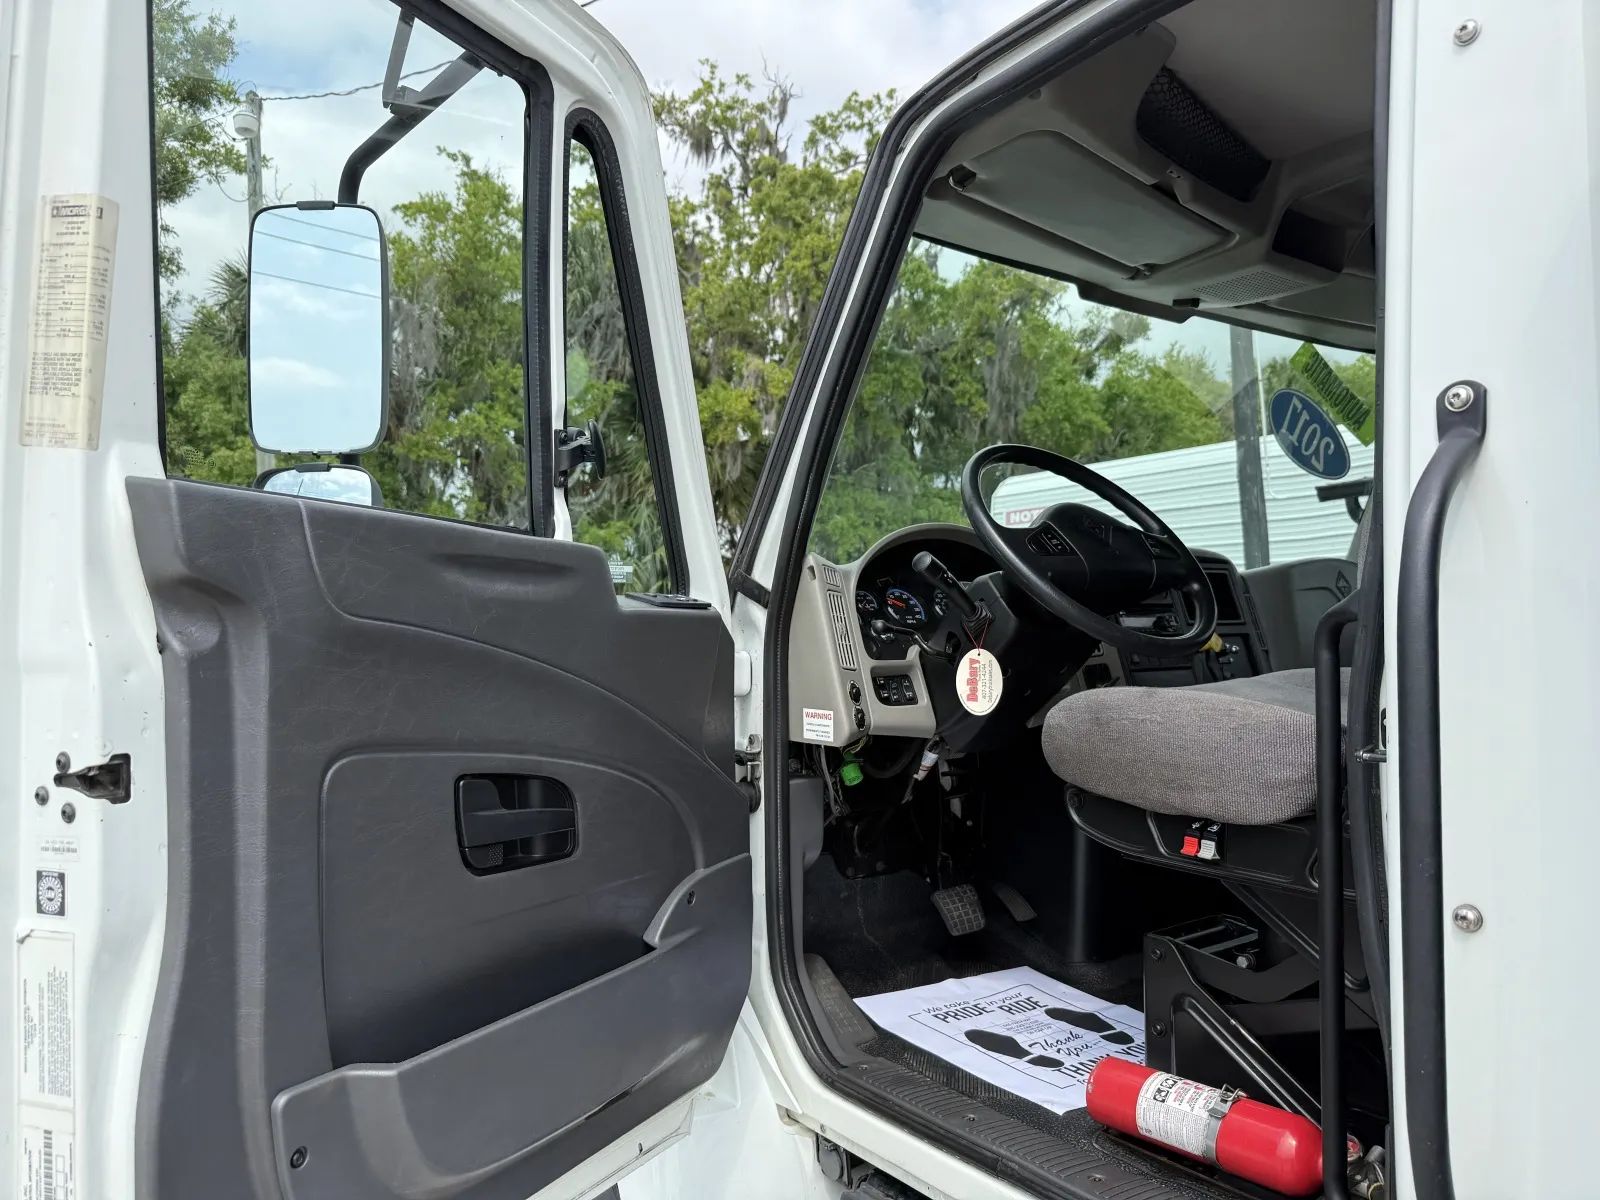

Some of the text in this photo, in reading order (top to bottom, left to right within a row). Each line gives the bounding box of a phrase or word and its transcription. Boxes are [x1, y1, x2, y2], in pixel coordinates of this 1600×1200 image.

[59, 206, 101, 217] MORGN
[966, 657, 981, 702] DeBary
[804, 711, 832, 721] WARNING
[923, 1000, 970, 1015] We take
[931, 992, 1023, 1024] PRIDE in your
[997, 996, 1049, 1015] RIDE
[1028, 1030, 1083, 1051] Thank
